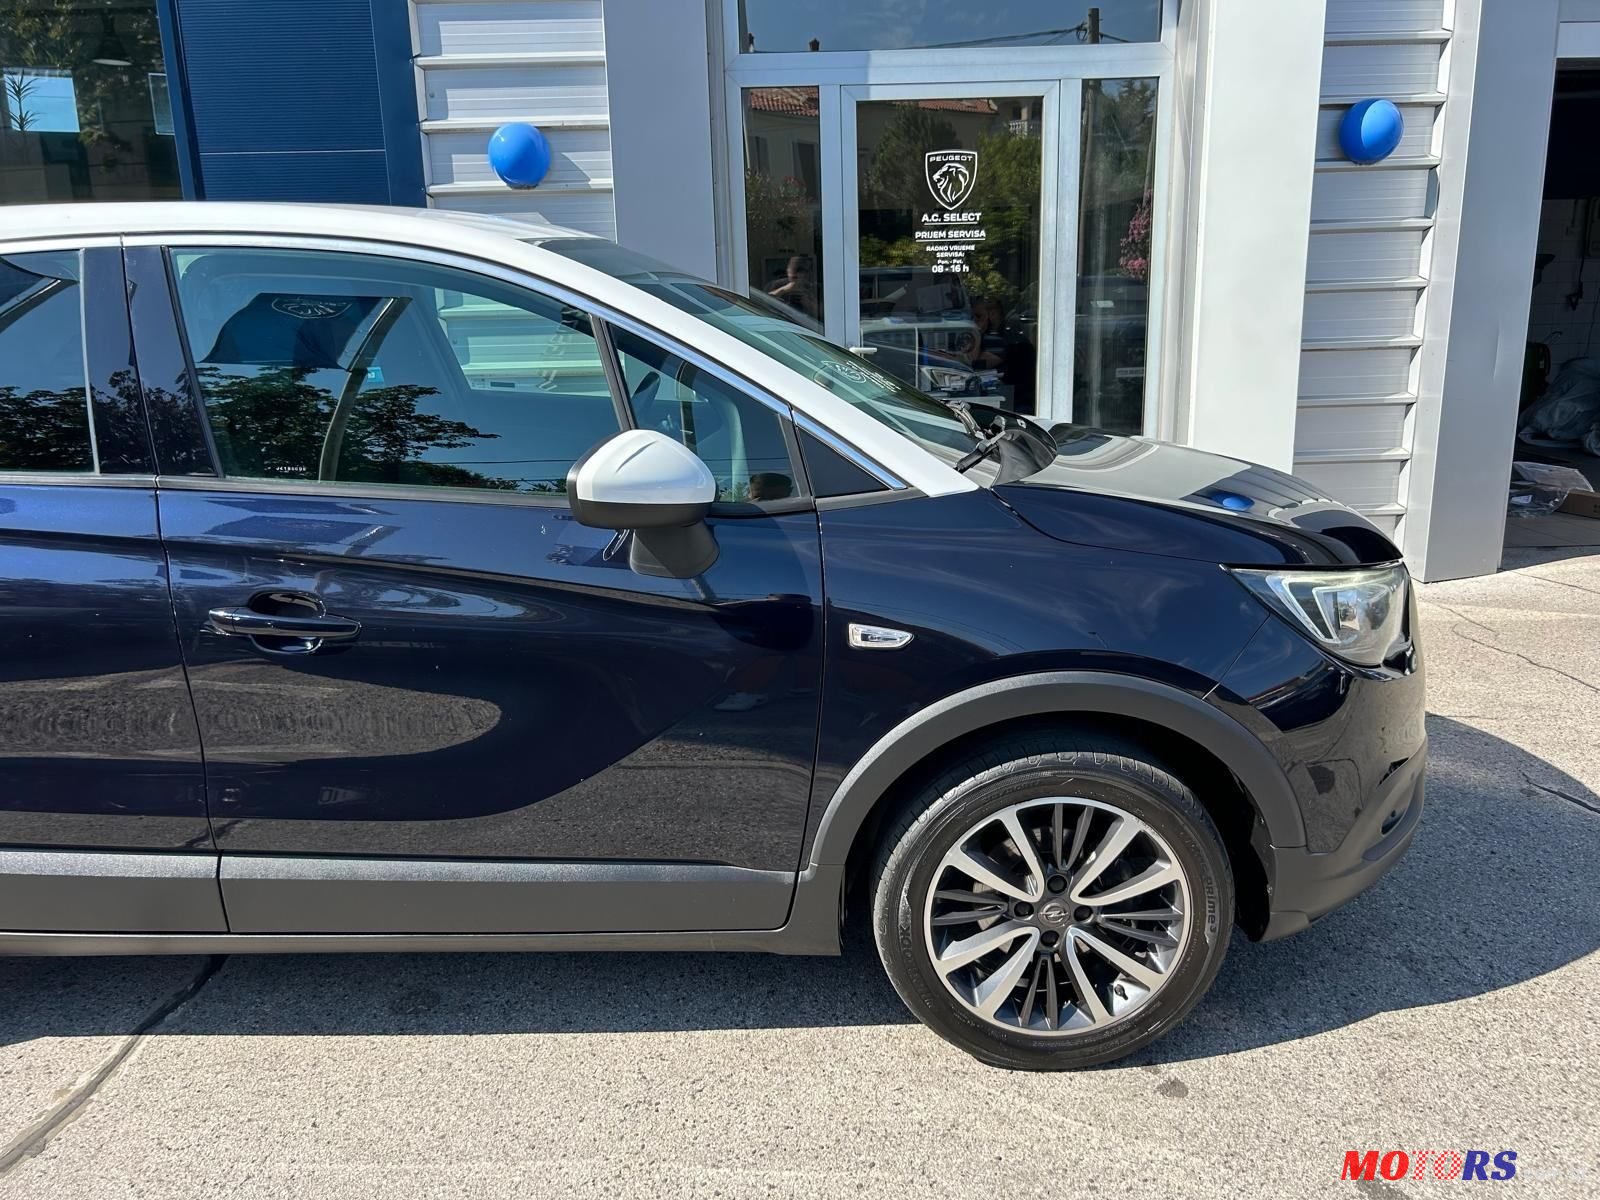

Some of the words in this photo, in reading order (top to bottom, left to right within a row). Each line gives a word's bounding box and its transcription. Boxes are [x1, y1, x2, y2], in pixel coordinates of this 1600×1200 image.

[929, 155, 973, 163] PEUGEOT
[922, 213, 941, 222] A.C.
[943, 212, 982, 222] SELECT
[915, 231, 947, 239] PRIJEM
[948, 230, 986, 238] SERVISA
[932, 265, 944, 273] 08
[950, 264, 961, 273] 16
[963, 264, 970, 273] h
